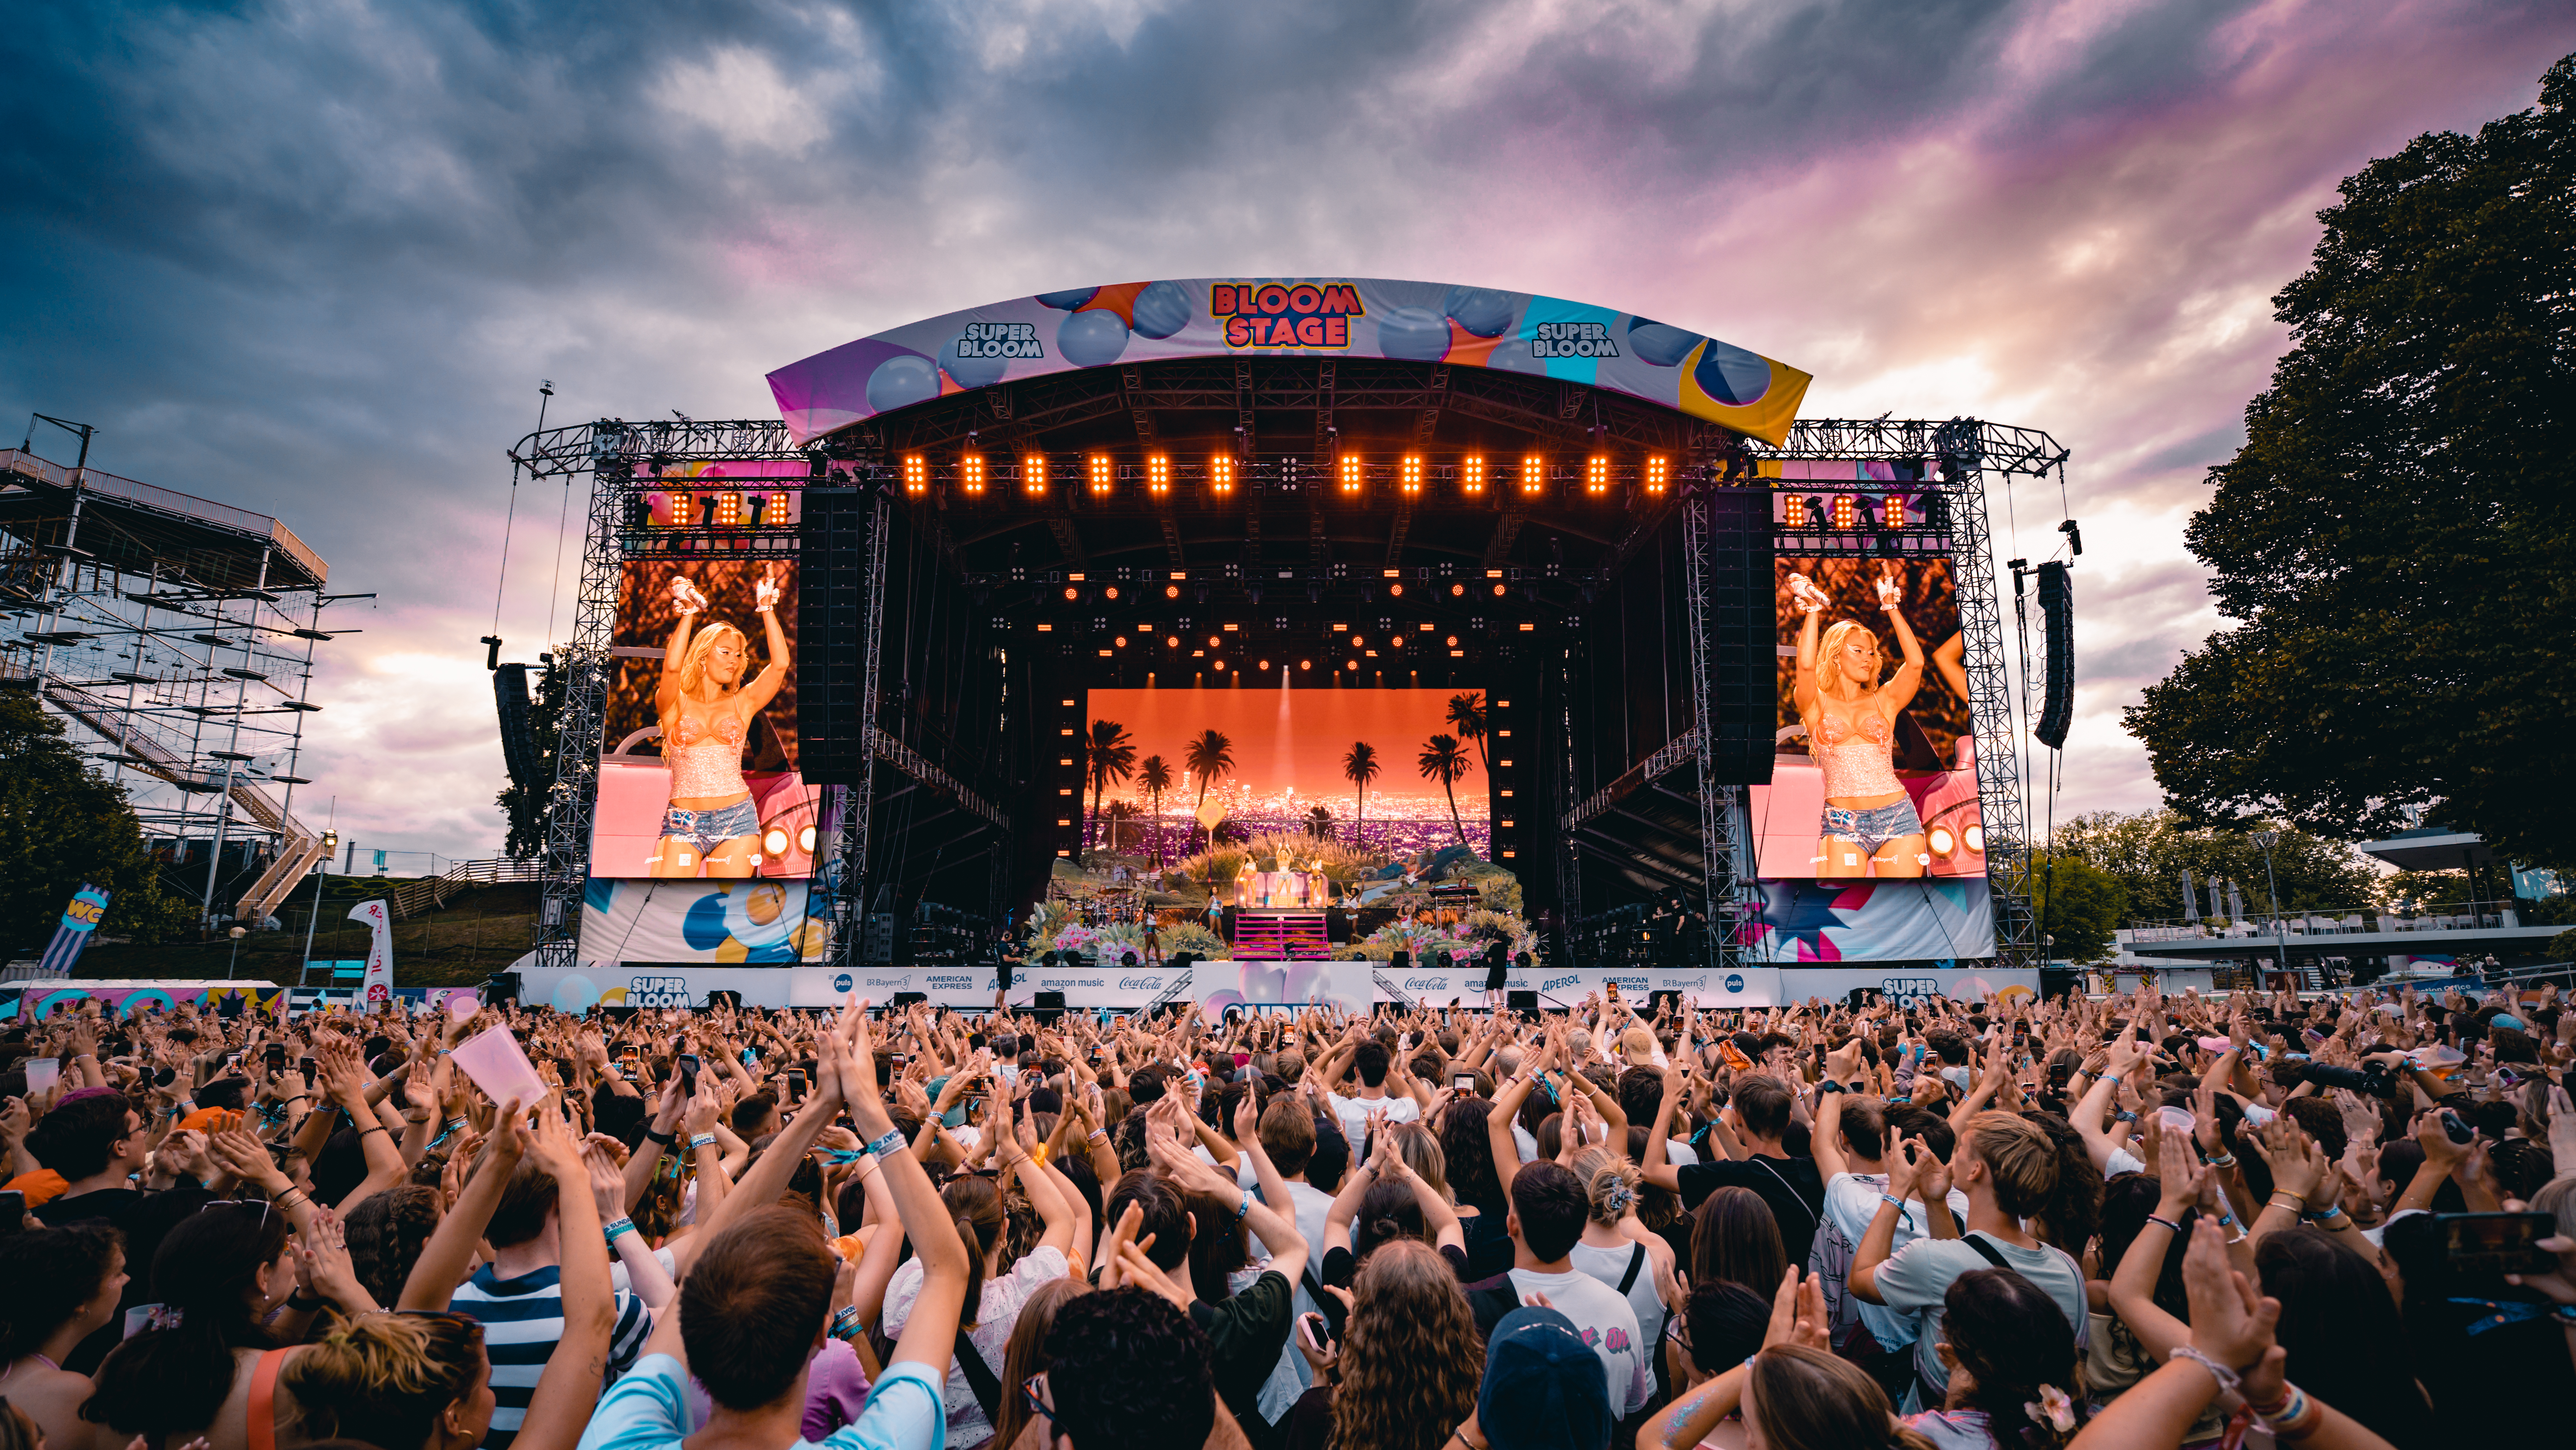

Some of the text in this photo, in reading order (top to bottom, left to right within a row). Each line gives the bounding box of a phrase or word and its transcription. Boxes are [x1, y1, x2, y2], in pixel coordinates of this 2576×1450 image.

[1215, 287, 1361, 314] BLOOM
[966, 324, 1035, 340] SUPER
[1228, 316, 1345, 345] STAGE
[1538, 323, 1608, 340] SUPER
[959, 340, 1042, 357] BLOOM
[1533, 340, 1618, 357] BLOOM
[645, 855, 663, 864] APEROL
[1810, 855, 1828, 864] APEROL
[67, 899, 104, 923] WC
[632, 977, 686, 993] SUPER
[836, 979, 851, 987] puls
[876, 979, 902, 988] Bayern
[987, 973, 1027, 992] AOL
[1078, 978, 1104, 987] music
[1119, 977, 1165, 989] Coca-Cola
[1405, 977, 1450, 990] Coca-Cola
[1541, 974, 1581, 993] APEROL
[1672, 980, 1698, 989] Bayern
[1727, 980, 1742, 988] puls
[1884, 979, 1940, 995] SUPER
[625, 993, 690, 1009] BLOOM
[692, 1137, 712, 1148] SUNDAY
[1872, 1333, 1901, 1347] erving
